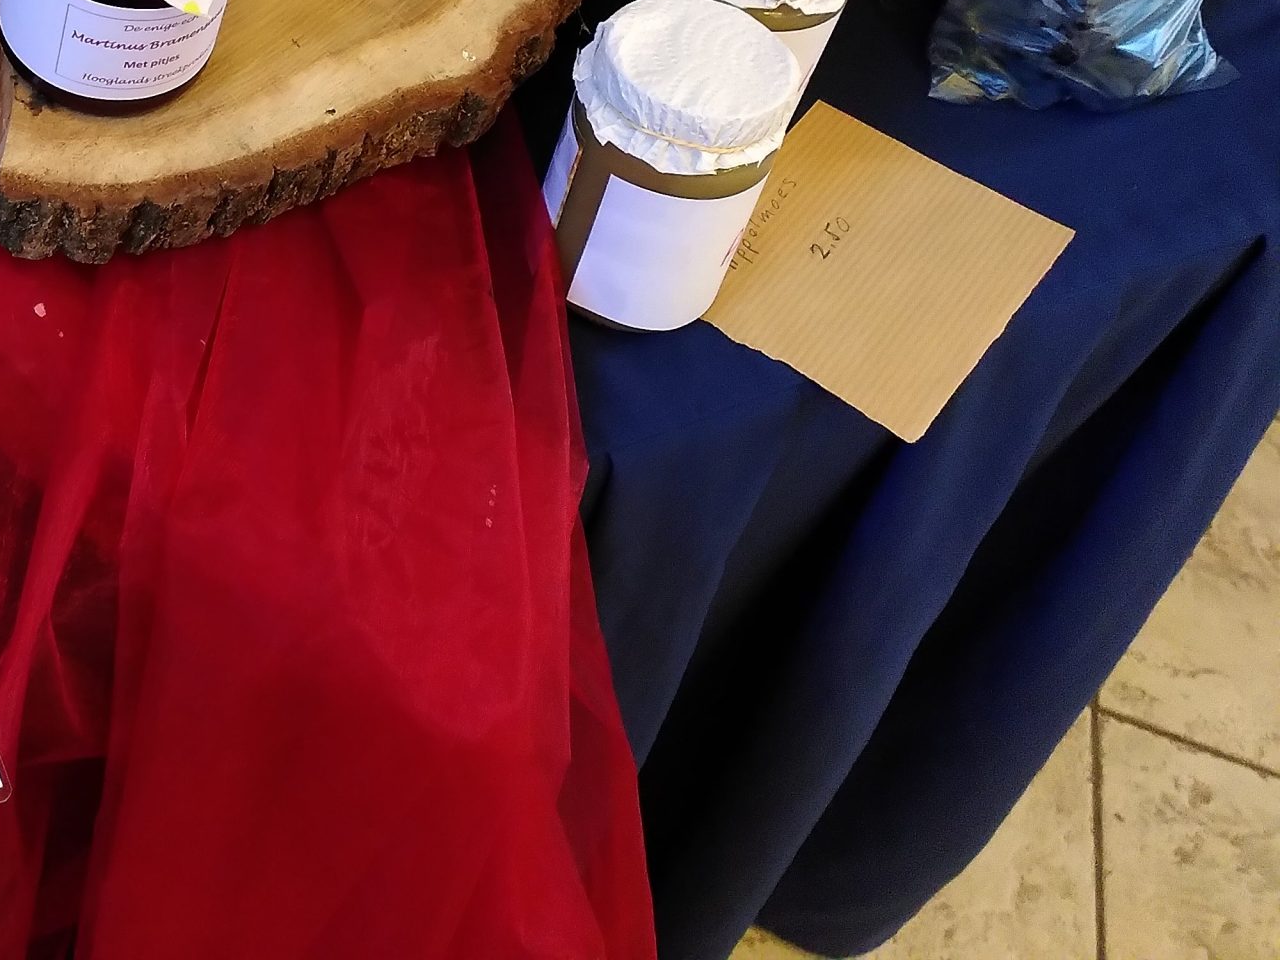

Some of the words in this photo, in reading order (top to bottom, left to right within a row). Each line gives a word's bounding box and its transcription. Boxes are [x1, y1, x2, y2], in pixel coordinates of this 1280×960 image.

[71, 29, 148, 51] Martinus
[123, 60, 148, 69] Met
[150, 53, 180, 68] pitjes
[82, 73, 149, 87] Hooglands
